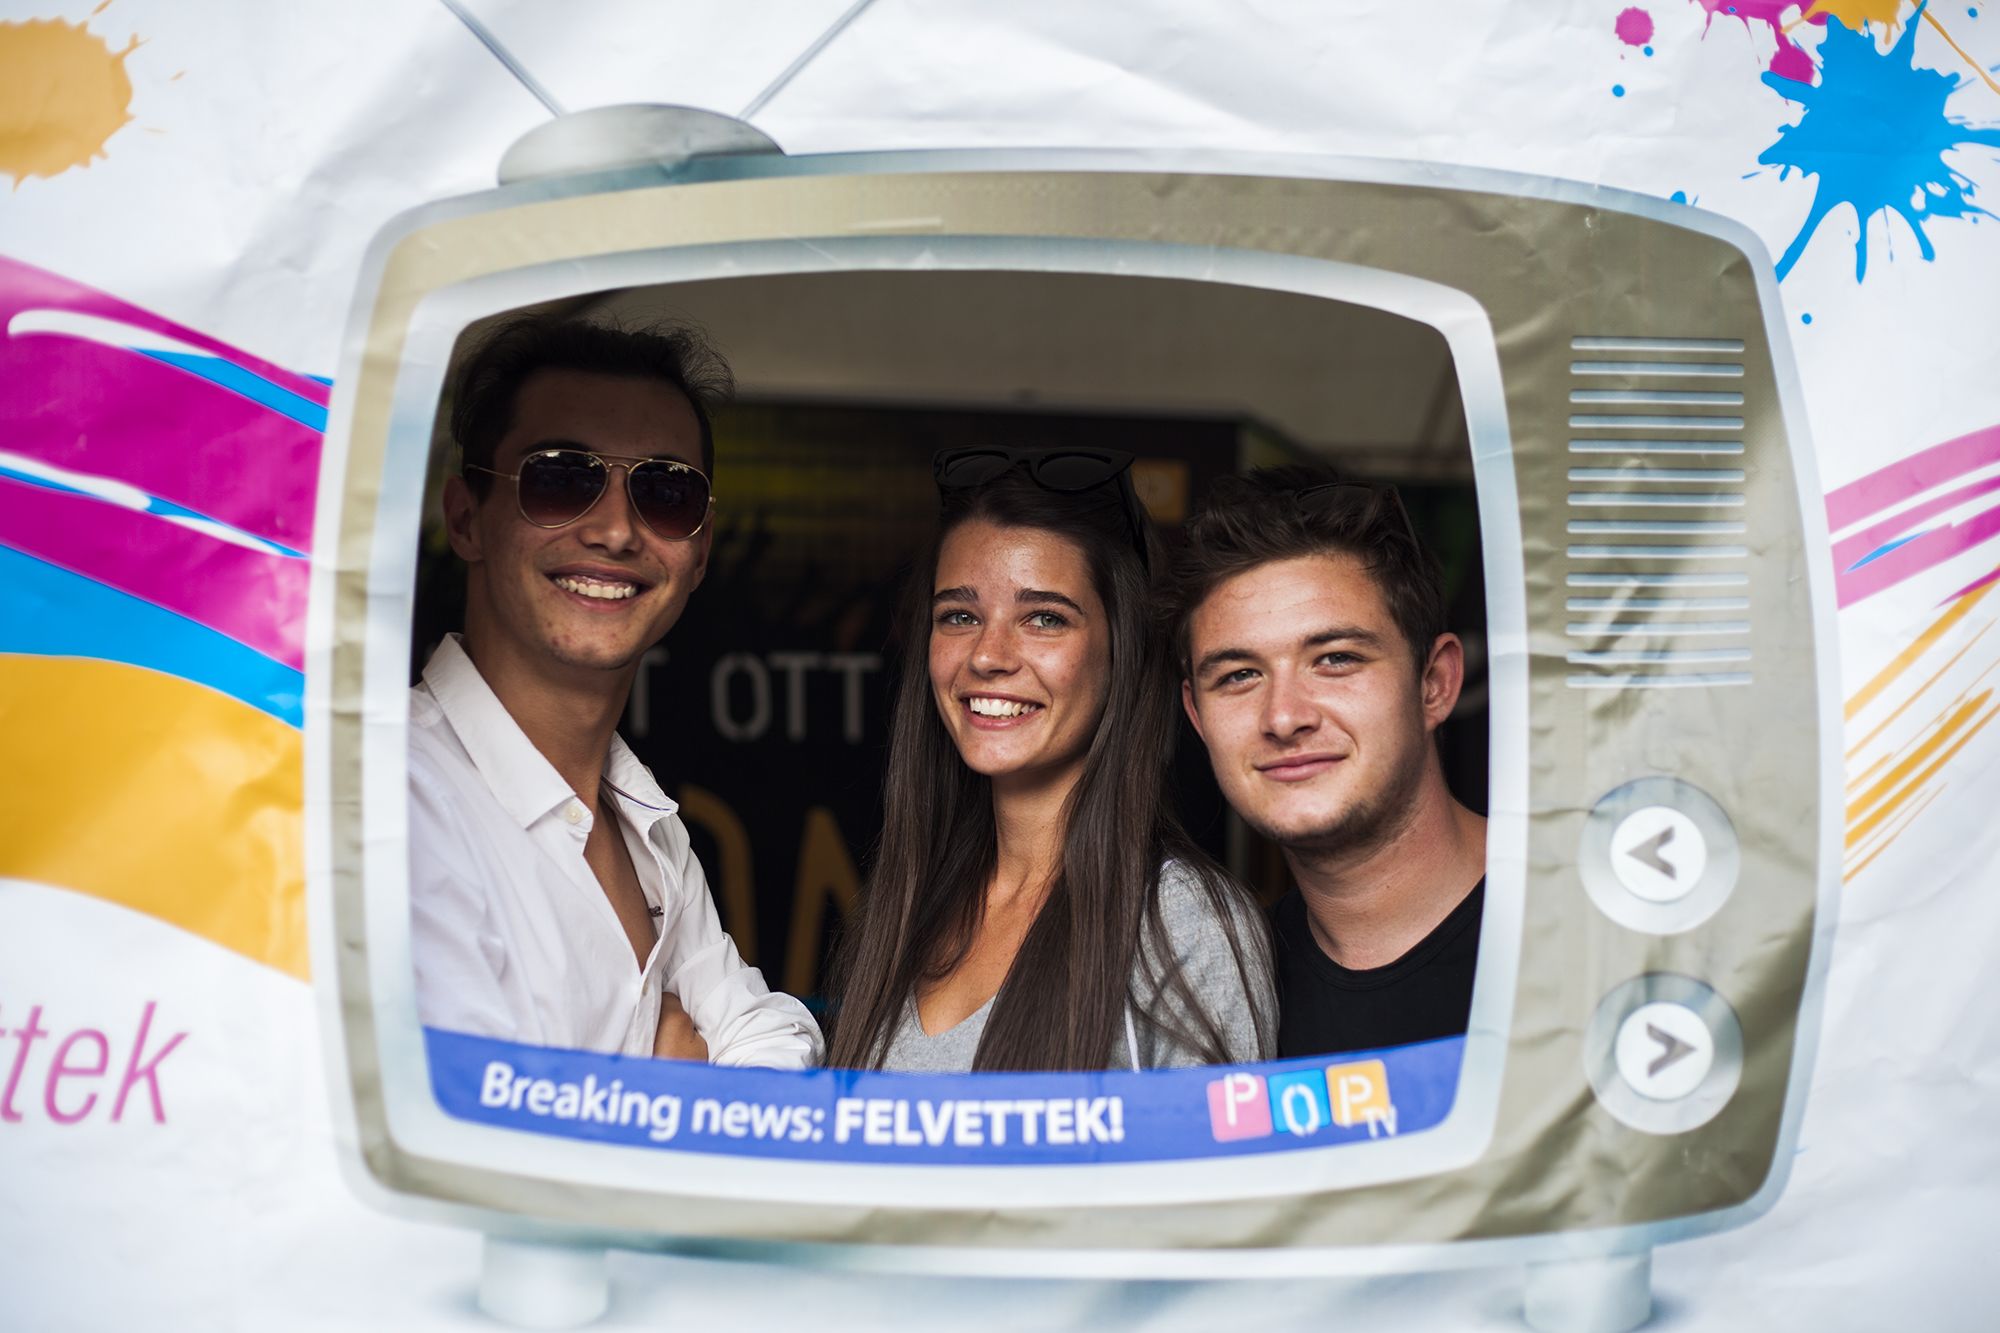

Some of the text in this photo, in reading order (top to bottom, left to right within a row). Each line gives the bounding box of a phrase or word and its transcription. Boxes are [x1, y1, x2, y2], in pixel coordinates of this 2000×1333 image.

[0, 1000, 190, 1126] tek
[480, 1061, 1125, 1146] Breaking news: FELVETTEK!
[1223, 1072, 1373, 1136] POP
